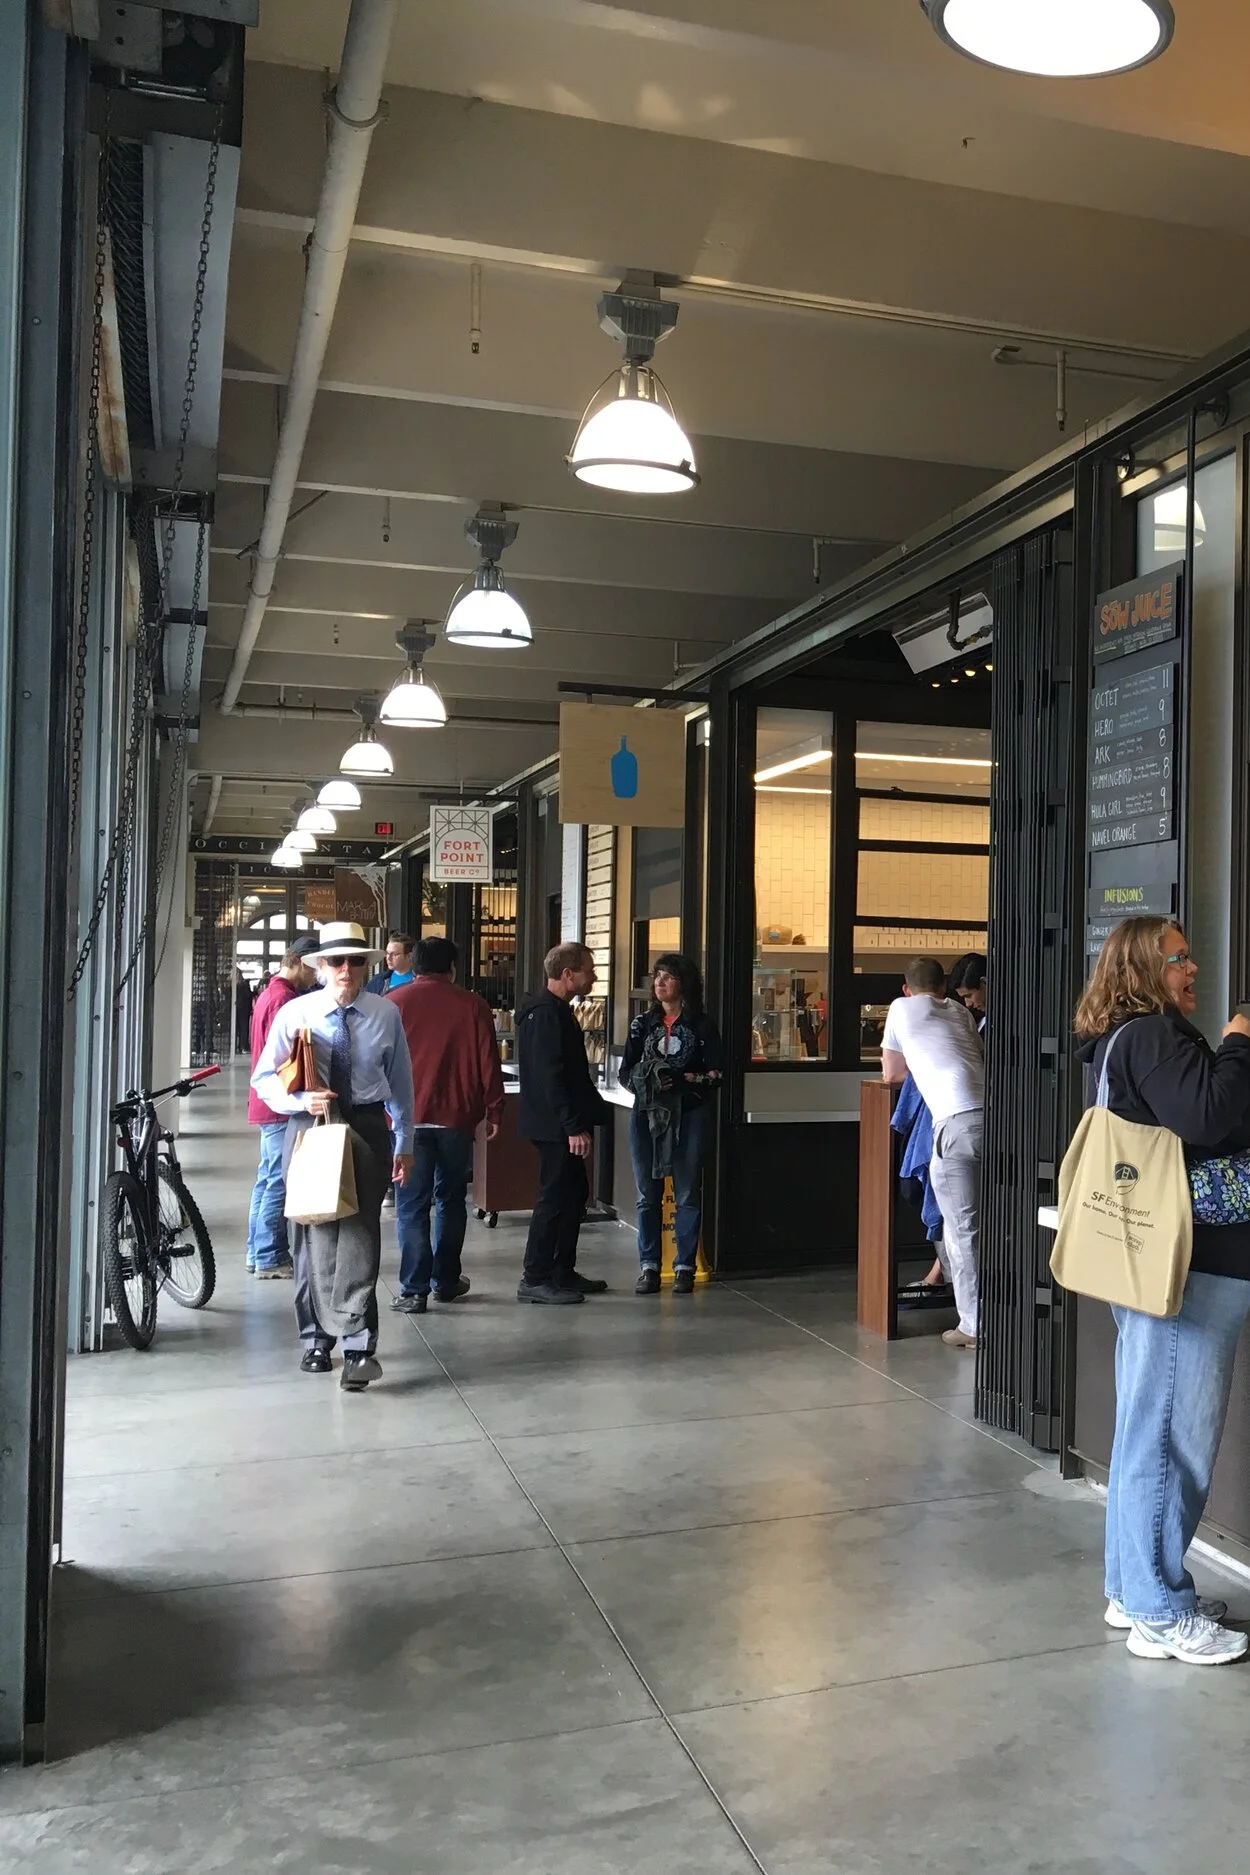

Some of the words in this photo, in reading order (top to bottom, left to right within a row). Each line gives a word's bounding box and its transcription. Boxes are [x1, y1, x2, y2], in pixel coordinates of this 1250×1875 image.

[1131, 582, 1172, 627] JUICE
[1094, 687, 1119, 710] OCTET
[1094, 718, 1114, 737] HERO
[1158, 698, 1165, 721] 9
[1094, 745, 1111, 765] ARK
[1158, 728, 1167, 748] 8
[1162, 756, 1171, 779] 8
[1092, 803, 1107, 819] HULA
[1107, 800, 1122, 816] GIRL
[1160, 786, 1166, 808] 9
[444, 840, 480, 851] FORT
[1092, 829, 1110, 847] NAVEL
[1111, 823, 1137, 842] ORANGE
[440, 852, 484, 863] POINT
[1104, 886, 1144, 904] INFUSIONS
[1104, 1196, 1150, 1218] Envonment
